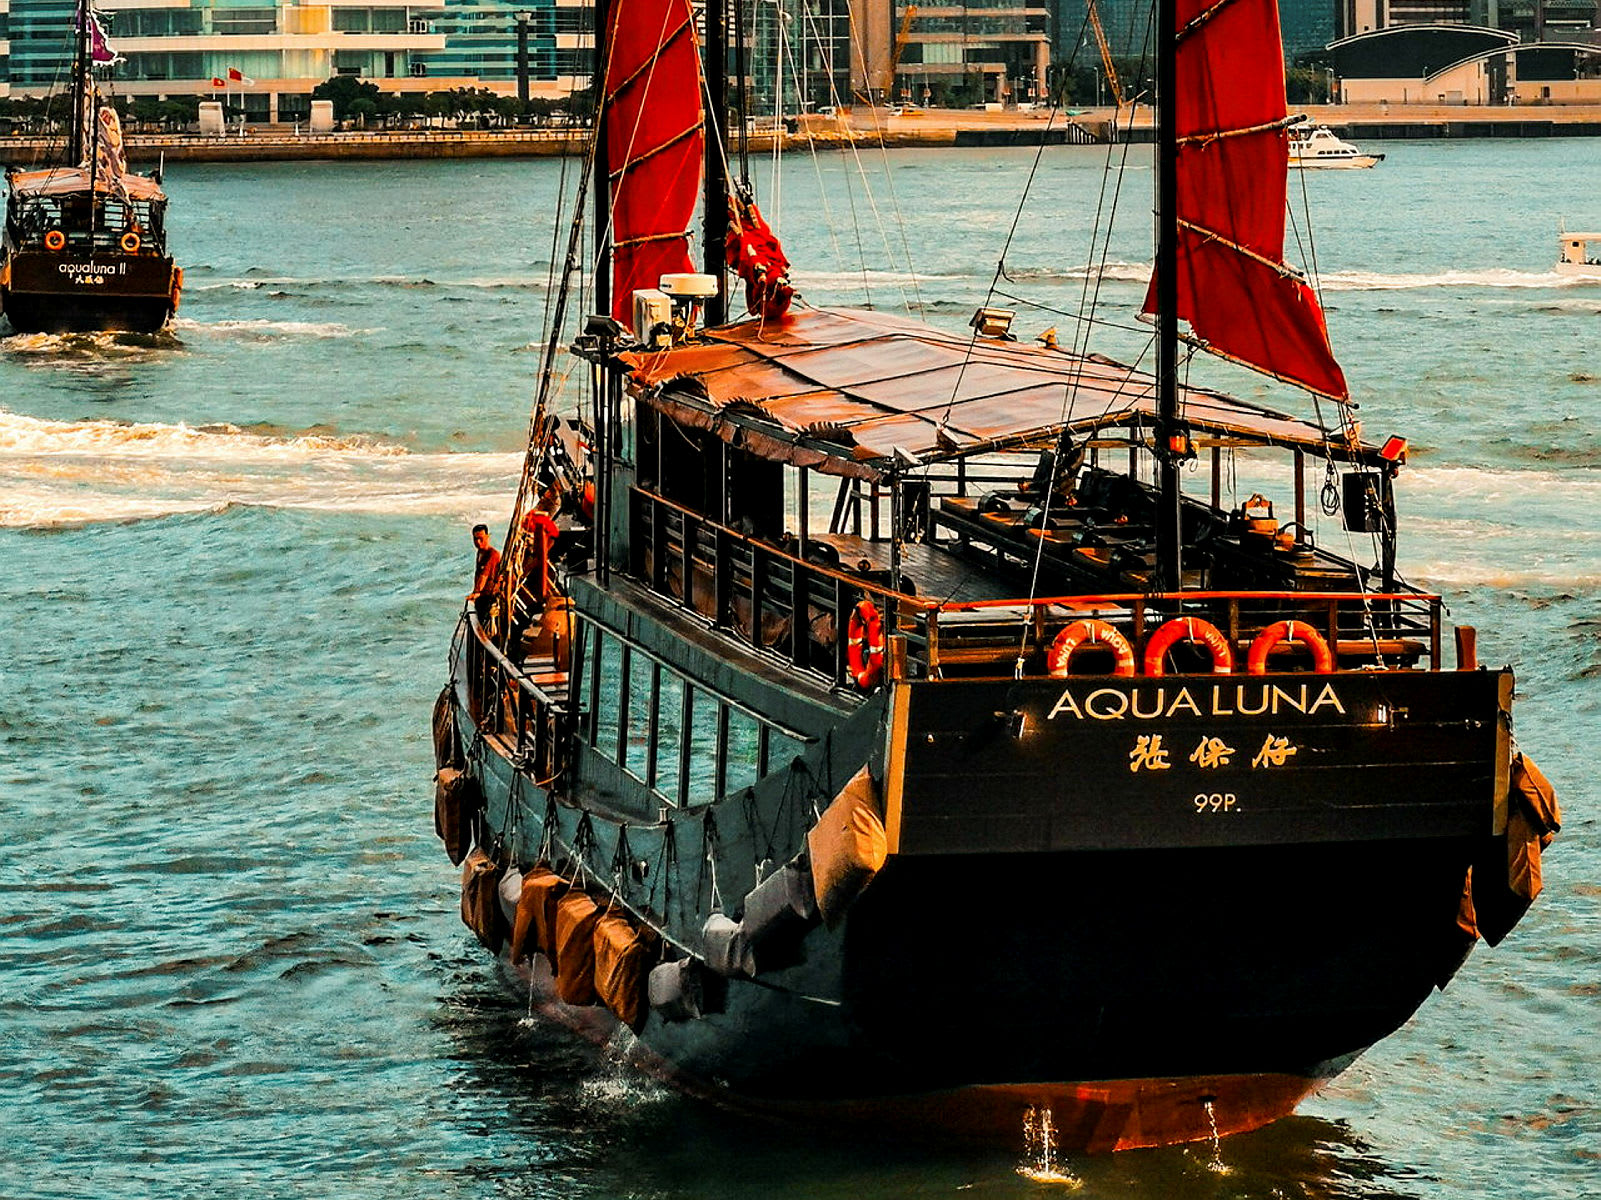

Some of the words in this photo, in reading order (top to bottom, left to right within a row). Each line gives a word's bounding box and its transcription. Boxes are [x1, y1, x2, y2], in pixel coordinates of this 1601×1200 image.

[58, 260, 116, 279] aqualuna
[1047, 686, 1202, 720] AQUA
[1212, 682, 1346, 716] LUNA
[1129, 733, 1298, 773] 張保仔
[1193, 793, 1243, 813] 99P.
